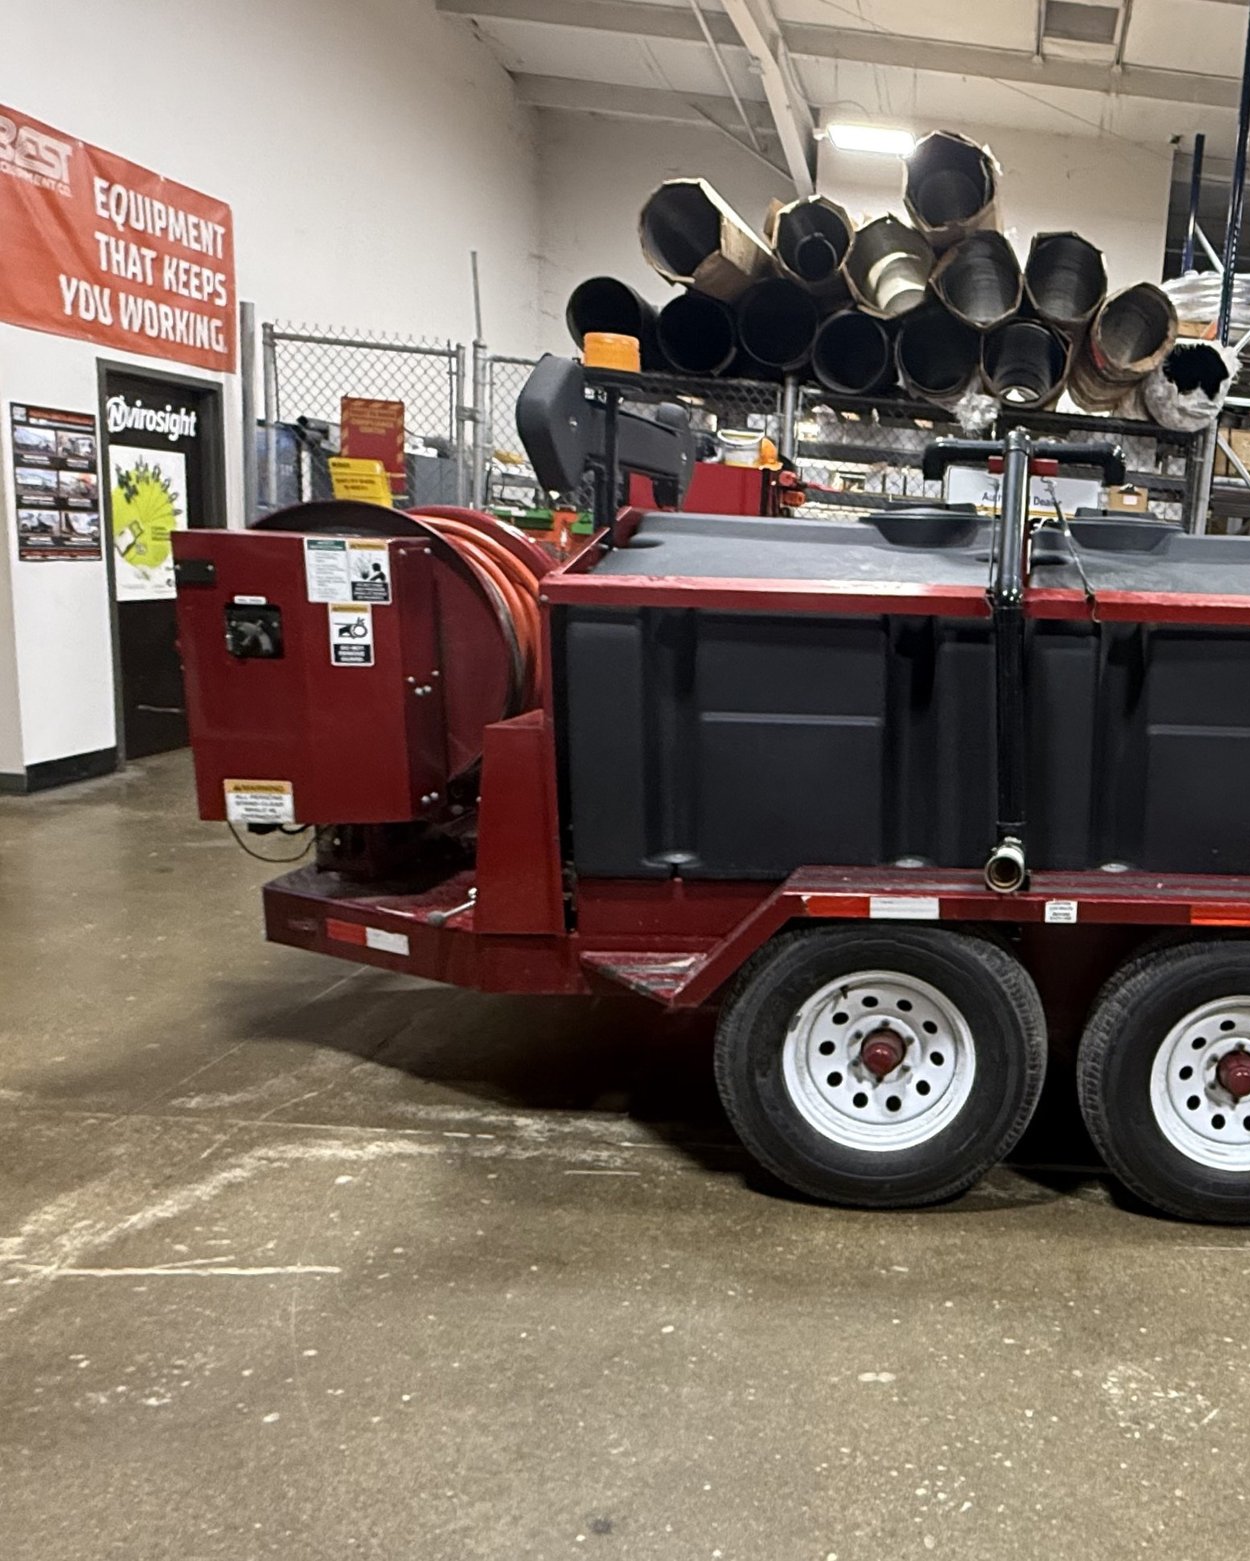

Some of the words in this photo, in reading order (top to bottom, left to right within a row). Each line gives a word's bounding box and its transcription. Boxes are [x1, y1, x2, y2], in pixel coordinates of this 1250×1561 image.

[93, 175, 226, 259] EQUIPMENT
[58, 273, 113, 327] YOU
[94, 231, 157, 286] THAT
[162, 254, 227, 307] KEEPS
